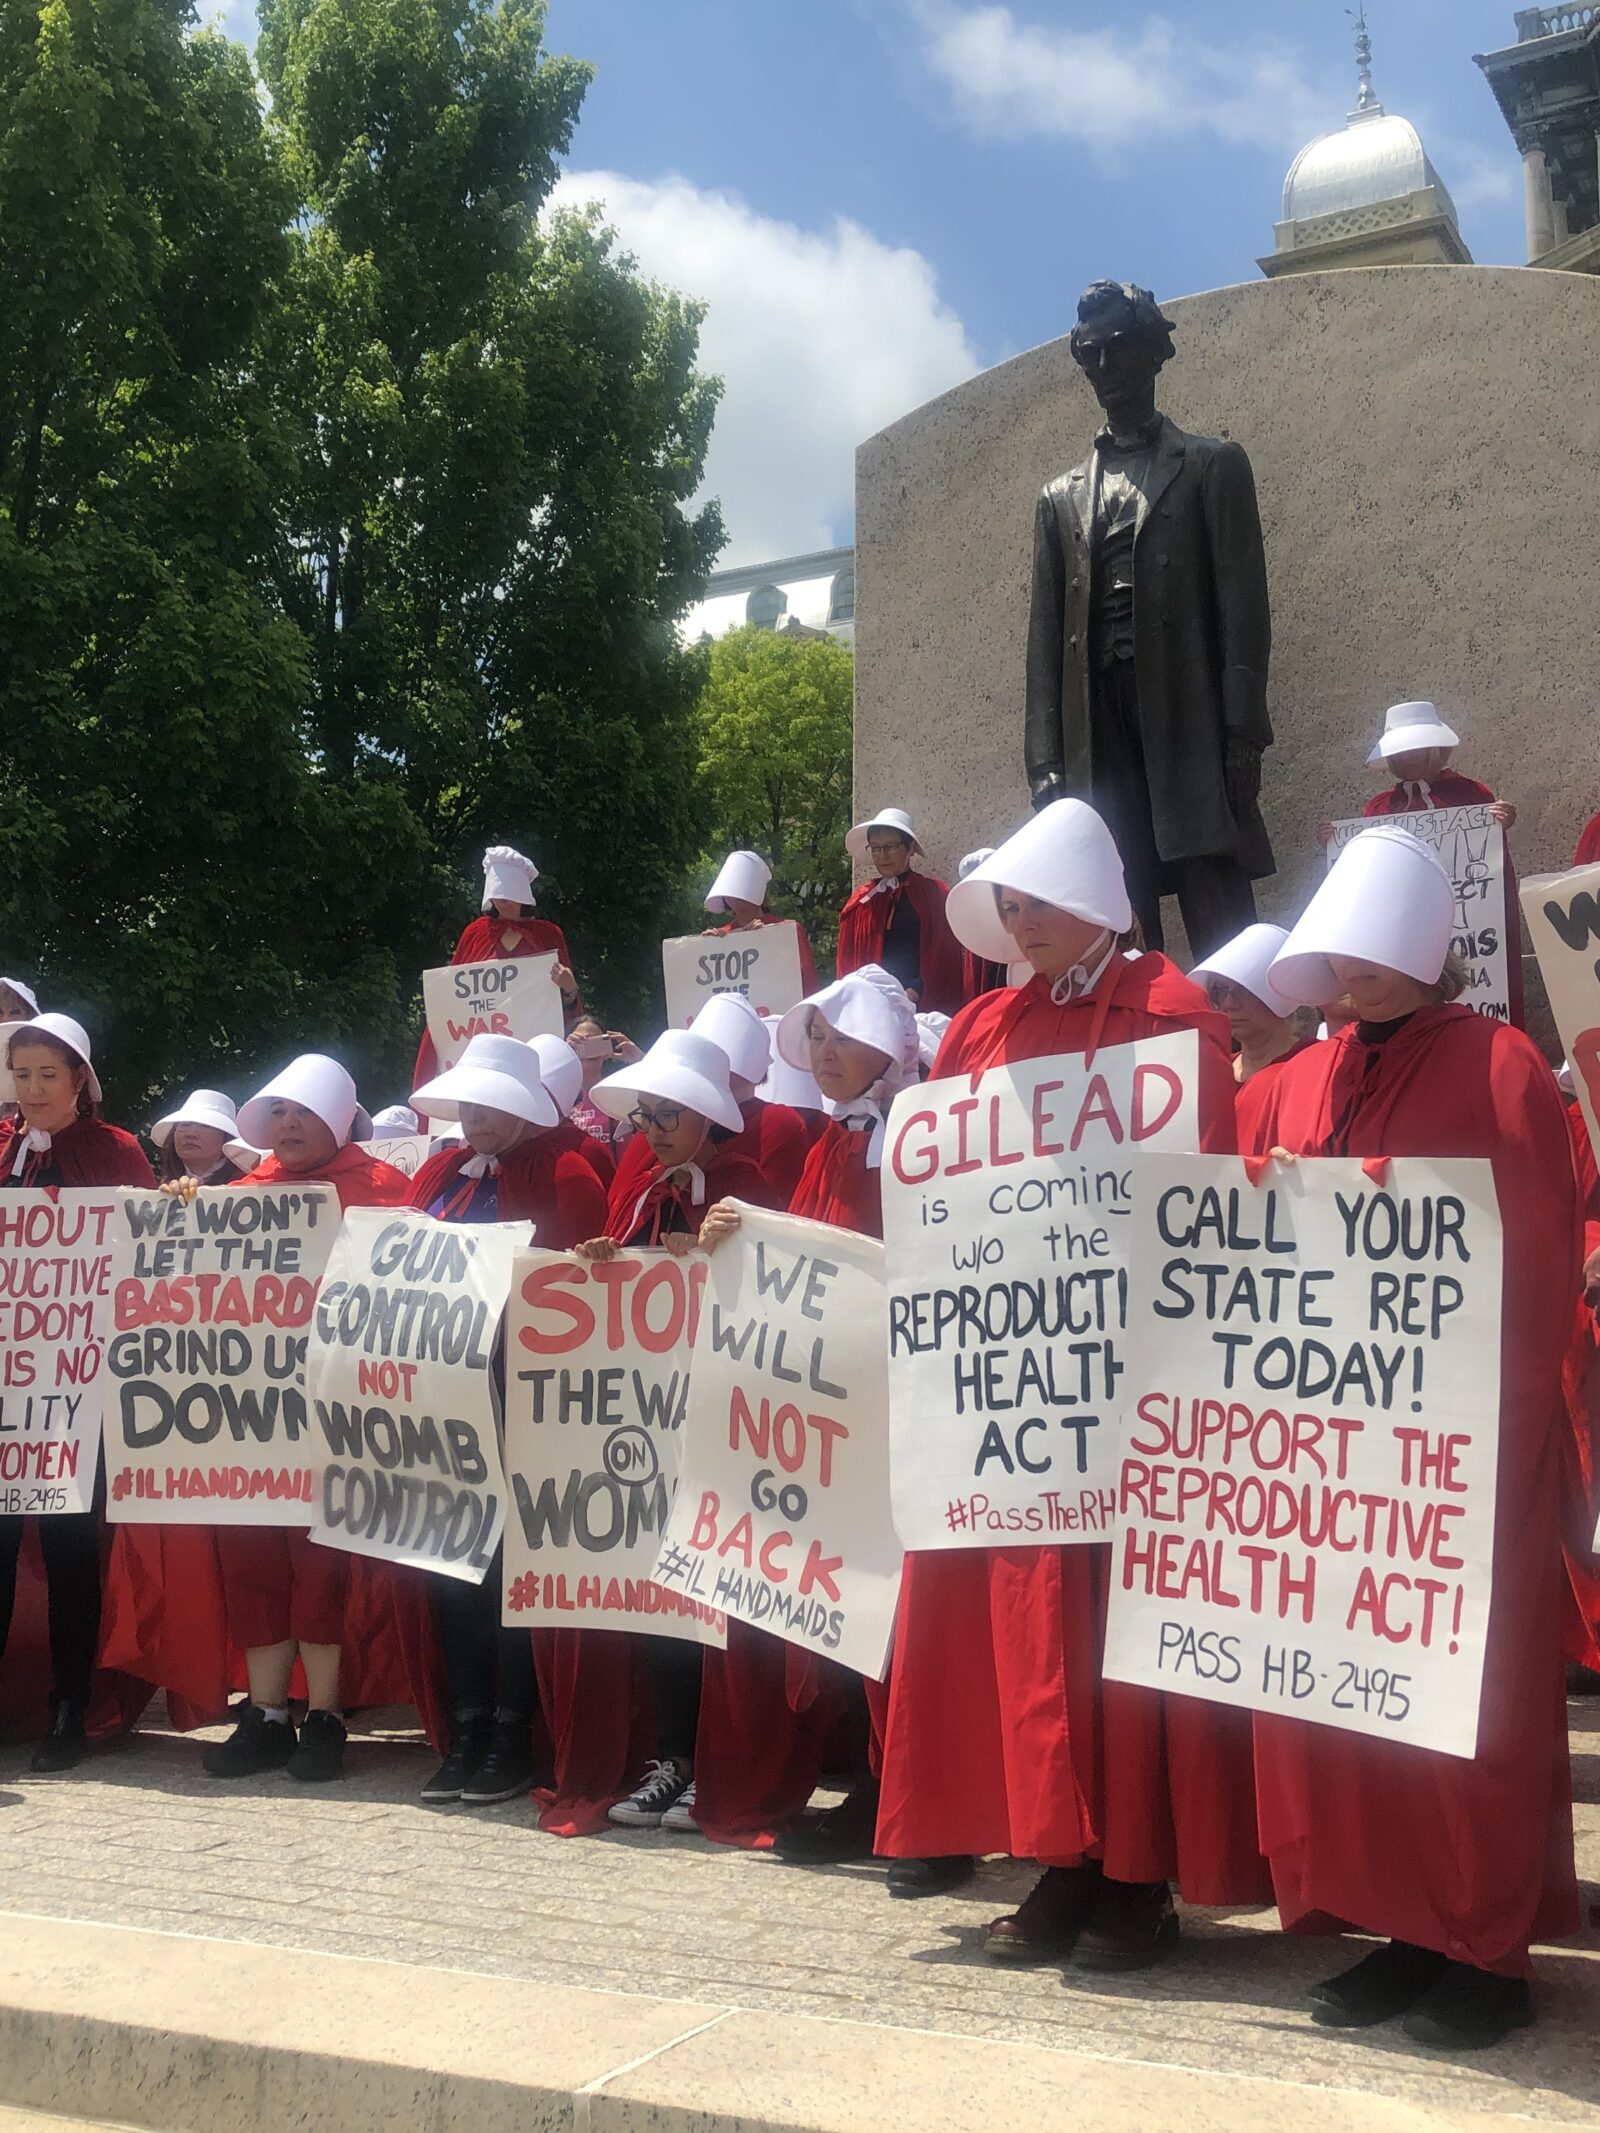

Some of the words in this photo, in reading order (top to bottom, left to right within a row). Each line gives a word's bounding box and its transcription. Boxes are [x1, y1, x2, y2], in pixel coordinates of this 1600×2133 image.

[1450, 806, 1497, 831] ACT
[454, 965, 518, 998] STOP
[696, 949, 760, 986] STOP
[447, 1013, 514, 1041] WAR
[469, 999, 497, 1015] THE
[892, 1063, 1184, 1186] GILEAD
[124, 1199, 188, 1239] WE
[195, 1194, 328, 1236] WON'T
[922, 1196, 950, 1226] is
[1043, 1223, 1111, 1262] the
[1156, 1186, 1297, 1254] CALL
[1336, 1191, 1471, 1263] YOUR
[133, 1239, 204, 1278] LET
[214, 1238, 301, 1275] THE
[371, 1221, 480, 1284] GUN
[757, 1241, 839, 1322] WE
[114, 1275, 323, 1332] BASTARD
[316, 1281, 491, 1370] CONTROL
[1152, 1257, 1335, 1327] STATE
[1370, 1271, 1464, 1340] REP
[5, 1350, 36, 1387] IS
[55, 1343, 101, 1387] NO
[107, 1329, 252, 1379] GRIND
[358, 1359, 418, 1402] NOT
[712, 1304, 848, 1400] WILL
[1213, 1331, 1424, 1413] TODAY!
[120, 1380, 308, 1450] DOWN
[518, 1367, 626, 1426] THE
[314, 1400, 489, 1485] WOMB
[611, 1440, 647, 1472] ON
[728, 1385, 850, 1488] NOT
[975, 1416, 1100, 1477] ACT
[1131, 1392, 1364, 1480] SUPPORT
[1393, 1426, 1472, 1493] THE
[322, 1464, 498, 1569] CONTROL
[511, 1468, 678, 1553] WOM
[750, 1469, 808, 1522] GO
[1120, 1459, 1465, 1570] REPRODUCTIVE
[688, 1490, 843, 1603] BACK
[1123, 1527, 1316, 1623] HEALTH
[1346, 1566, 1464, 1655] ACT!
[1157, 1621, 1242, 1685] PASS
